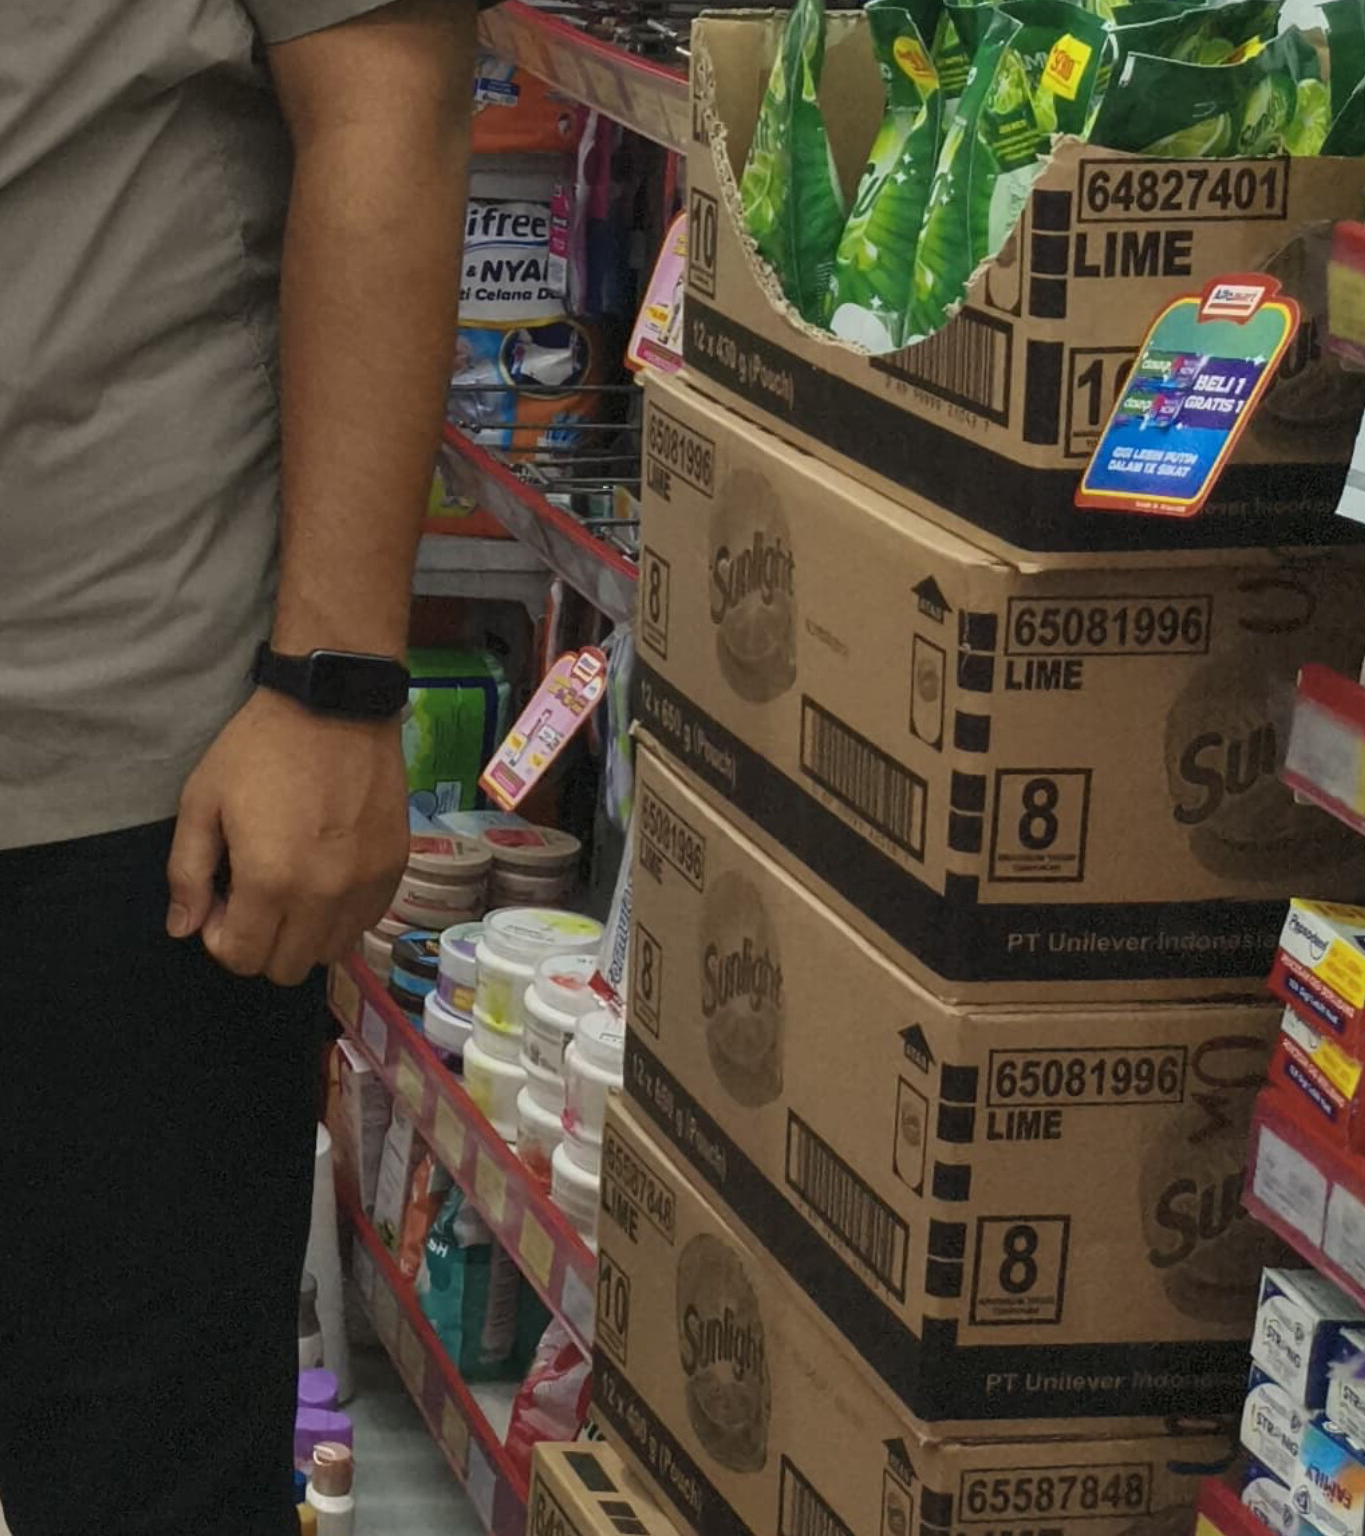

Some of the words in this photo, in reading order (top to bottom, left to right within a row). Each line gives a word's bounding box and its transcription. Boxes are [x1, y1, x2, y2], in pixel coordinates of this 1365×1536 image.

[1086, 164, 1279, 215] 64827401
[467, 201, 547, 240] ifree
[692, 197, 716, 269] 10
[1076, 231, 1194, 278] LIME
[474, 286, 534, 303] Celana
[692, 321, 708, 353] 12
[1183, 395, 1235, 414] GRATIS
[1195, 373, 1234, 395] BELI
[648, 414, 713, 490] 65081996
[648, 463, 672, 499] LIME
[646, 561, 662, 622] 8
[710, 531, 796, 624] Sunlight
[1014, 604, 1203, 647] 65081996
[1005, 659, 1083, 692] LIME
[1018, 776, 1059, 851] 8
[642, 796, 703, 880] 65081996
[641, 841, 664, 885] LIME
[1007, 932, 1039, 952] PT
[1049, 931, 1149, 952] Unilever
[640, 941, 655, 995] 8
[994, 1057, 1179, 1099] 65081996
[986, 1110, 1063, 1140] LIME
[603, 1193, 639, 1243] LIME
[997, 1224, 1038, 1295] 8
[601, 1271, 627, 1337] 10
[681, 1305, 766, 1381] Sunlight
[985, 1372, 1019, 1392] PT
[1026, 1371, 1124, 1391] Unilever
[1255, 1411, 1300, 1458] STRONG
[967, 1472, 1144, 1514] 65587848
